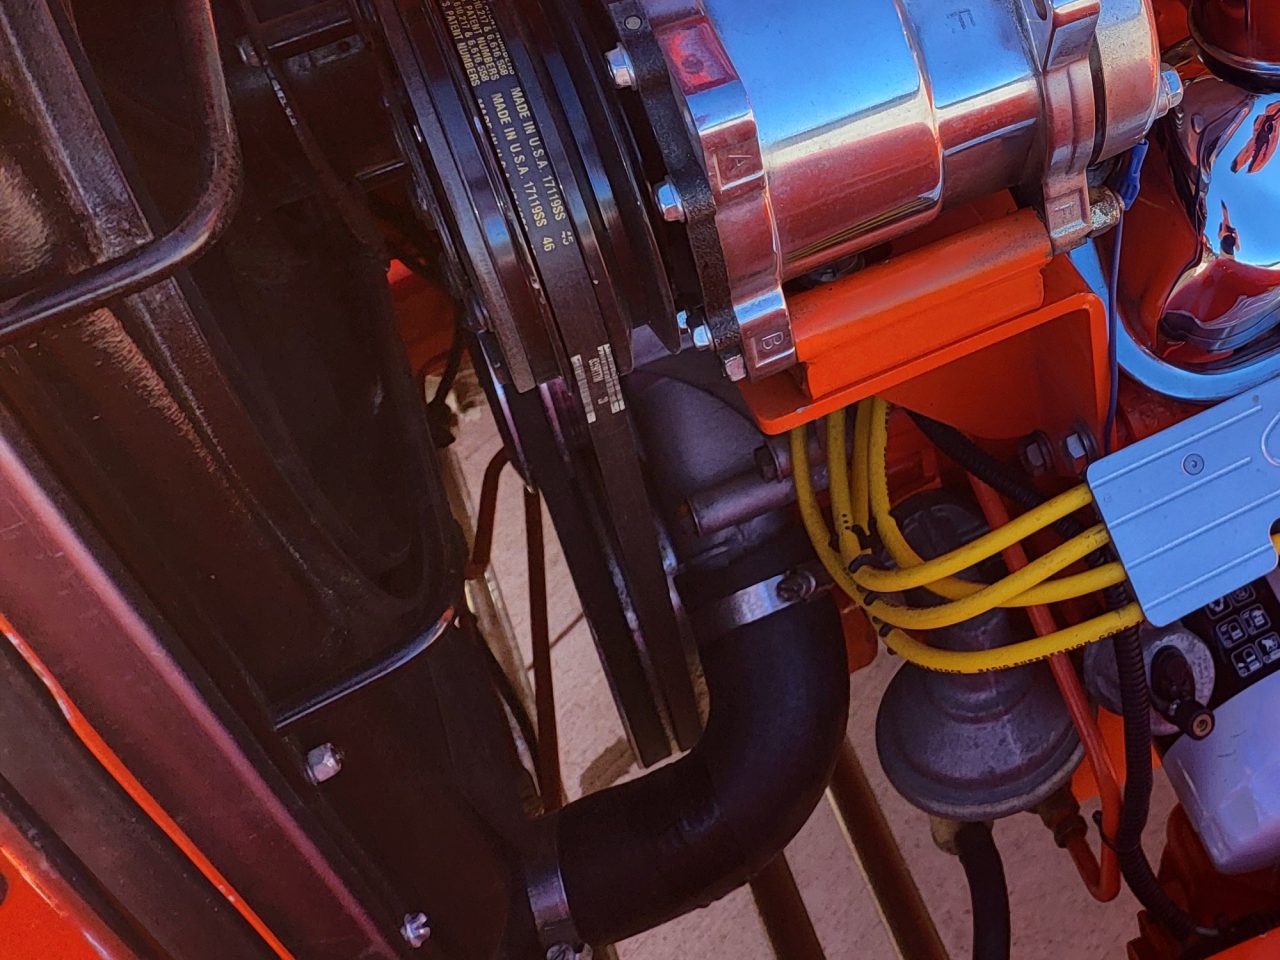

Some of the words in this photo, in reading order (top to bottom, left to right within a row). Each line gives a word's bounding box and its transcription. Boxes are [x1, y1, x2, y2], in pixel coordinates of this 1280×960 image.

[446, 10, 464, 40] PATENT
[456, 41, 480, 87] NUMBERS
[464, 5, 483, 35] PATENT
[476, 36, 499, 81] NUMBERS
[490, 92, 512, 126] MADE
[510, 86, 531, 120] MADE
[503, 127, 518, 141] IN
[522, 120, 537, 135] IN
[509, 143, 530, 179] U.S.A.
[528, 136, 549, 173] U.S.A.
[542, 236, 556, 252] 46
[761, 331, 784, 350] B
